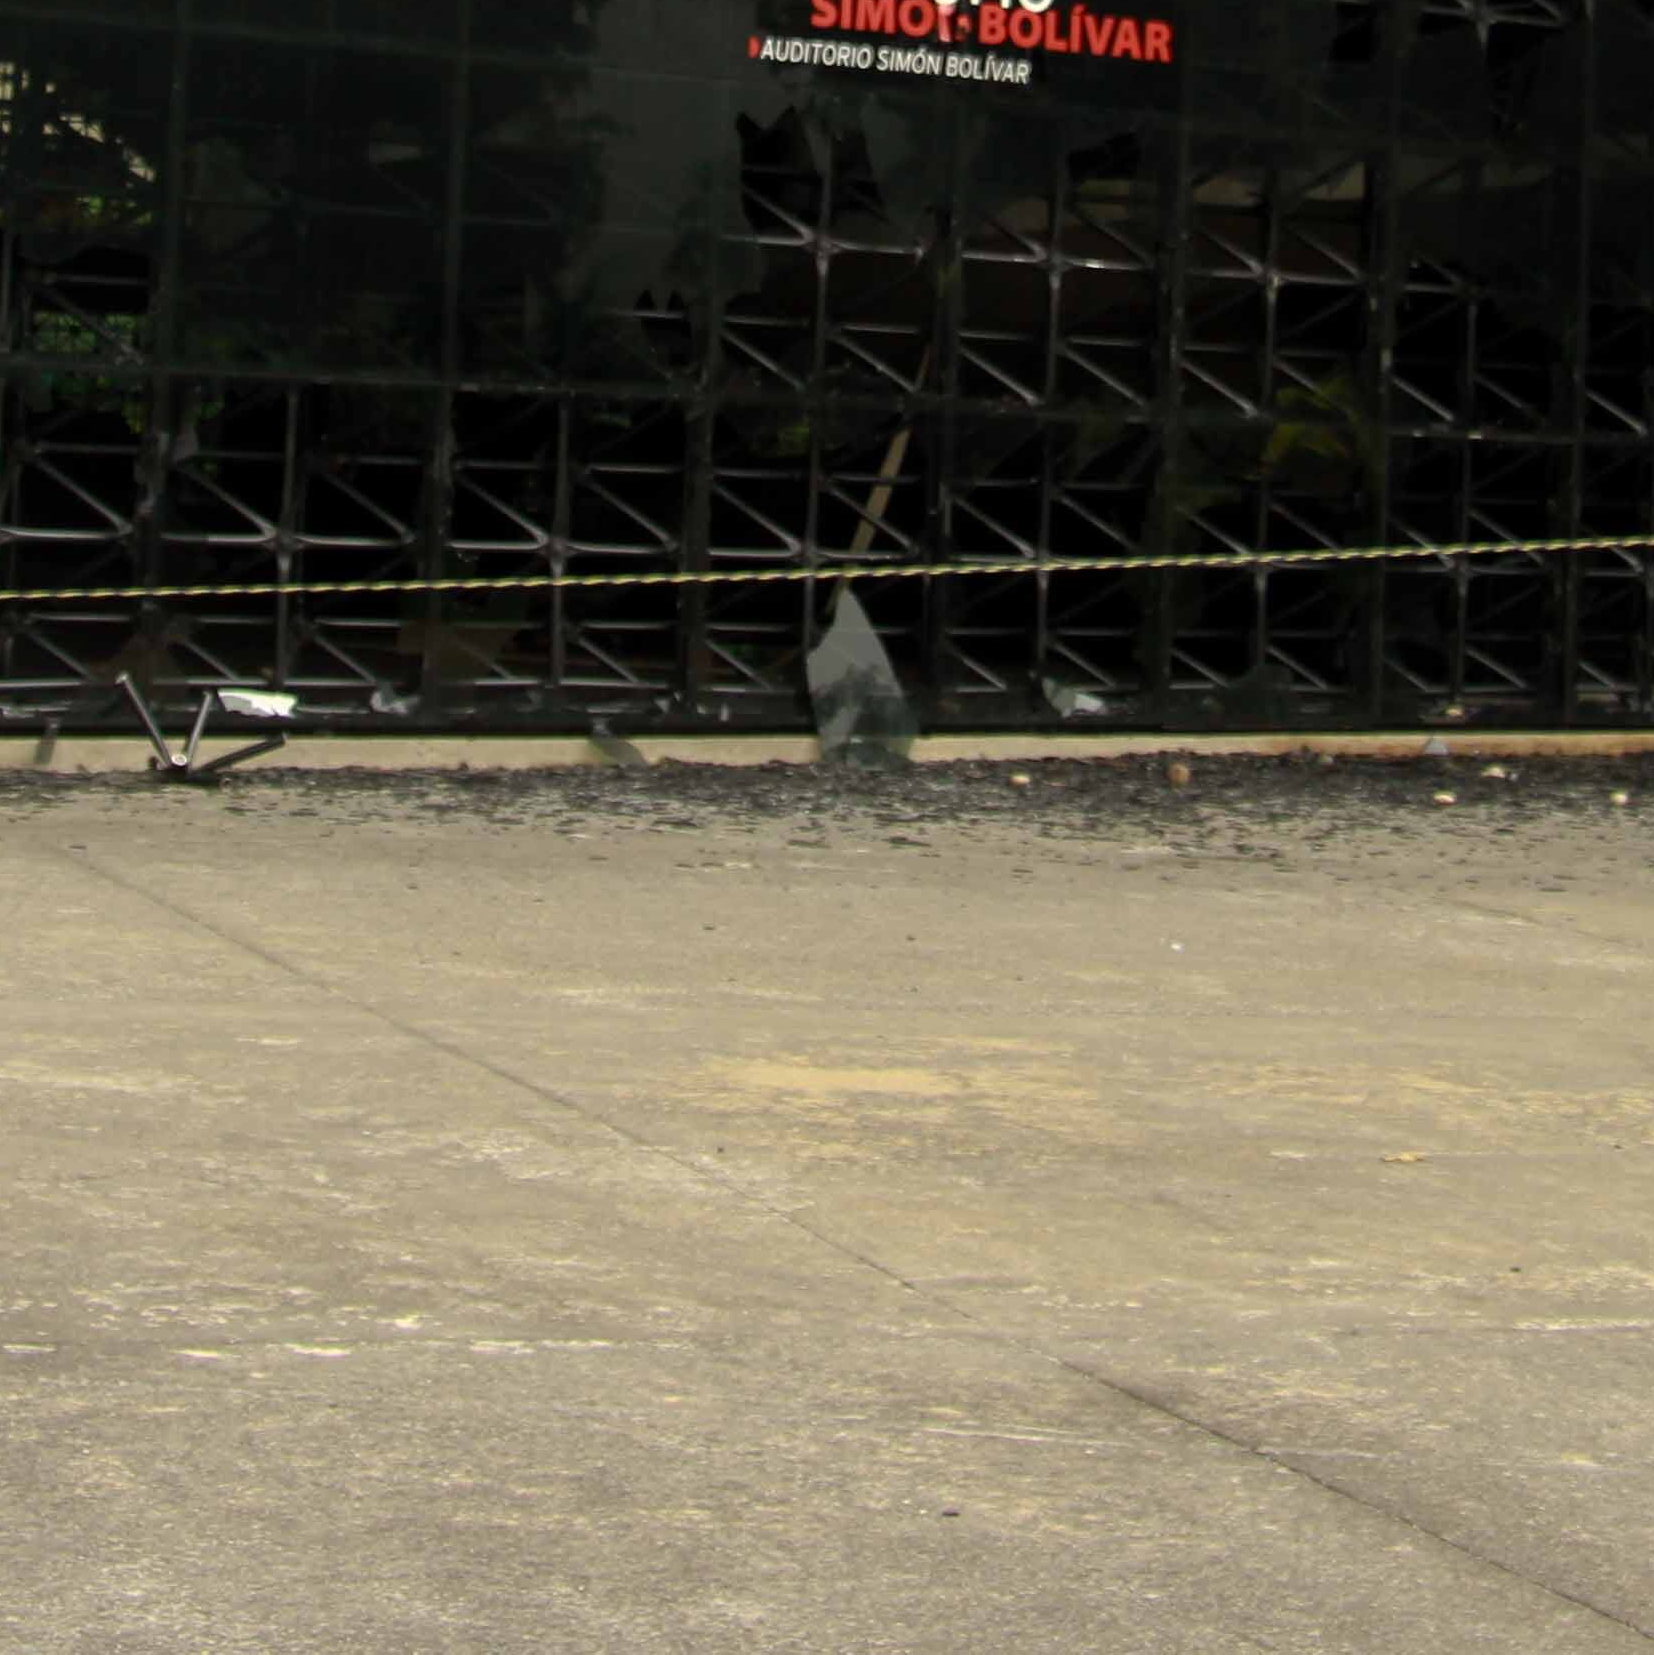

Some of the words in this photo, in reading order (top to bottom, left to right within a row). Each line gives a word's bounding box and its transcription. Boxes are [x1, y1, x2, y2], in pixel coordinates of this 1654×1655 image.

[978, 2, 1174, 63] BOLÍVAR
[760, 36, 872, 70] AUDITORIO
[876, 48, 942, 76] SIMÓN
[945, 54, 1032, 85] BOLÍVAR
